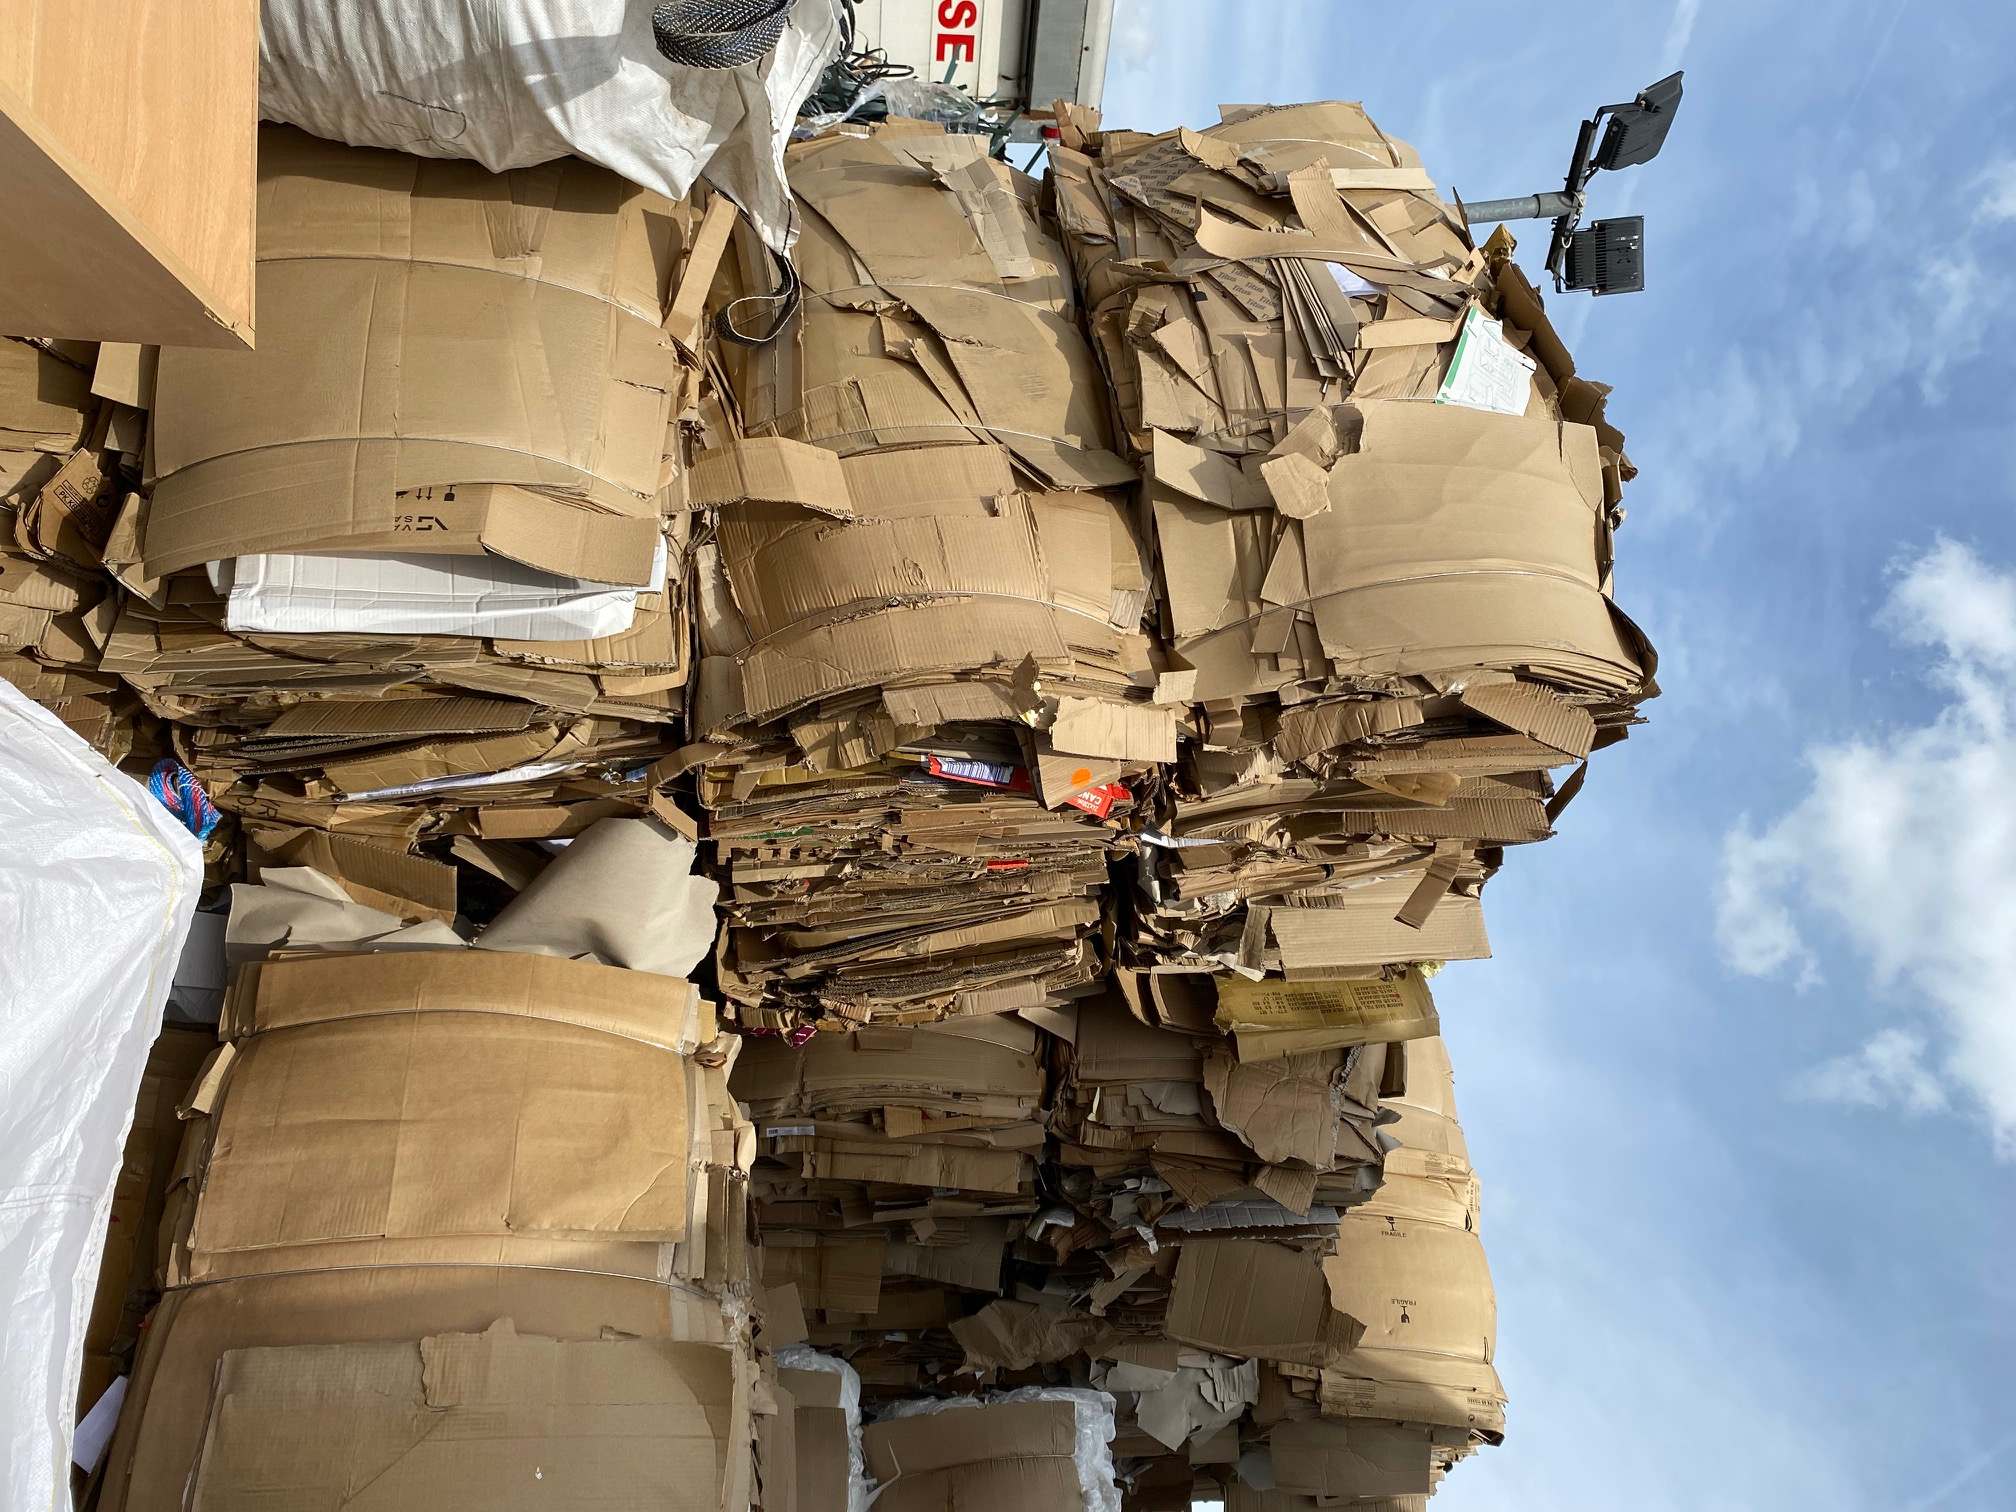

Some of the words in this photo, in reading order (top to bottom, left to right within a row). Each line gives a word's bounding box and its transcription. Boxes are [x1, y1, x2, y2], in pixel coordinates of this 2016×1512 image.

[936, 0, 977, 63] SE
[1381, 1229, 1407, 1238] FRAGILE
[1391, 1298, 1417, 1306] FRAGILE
